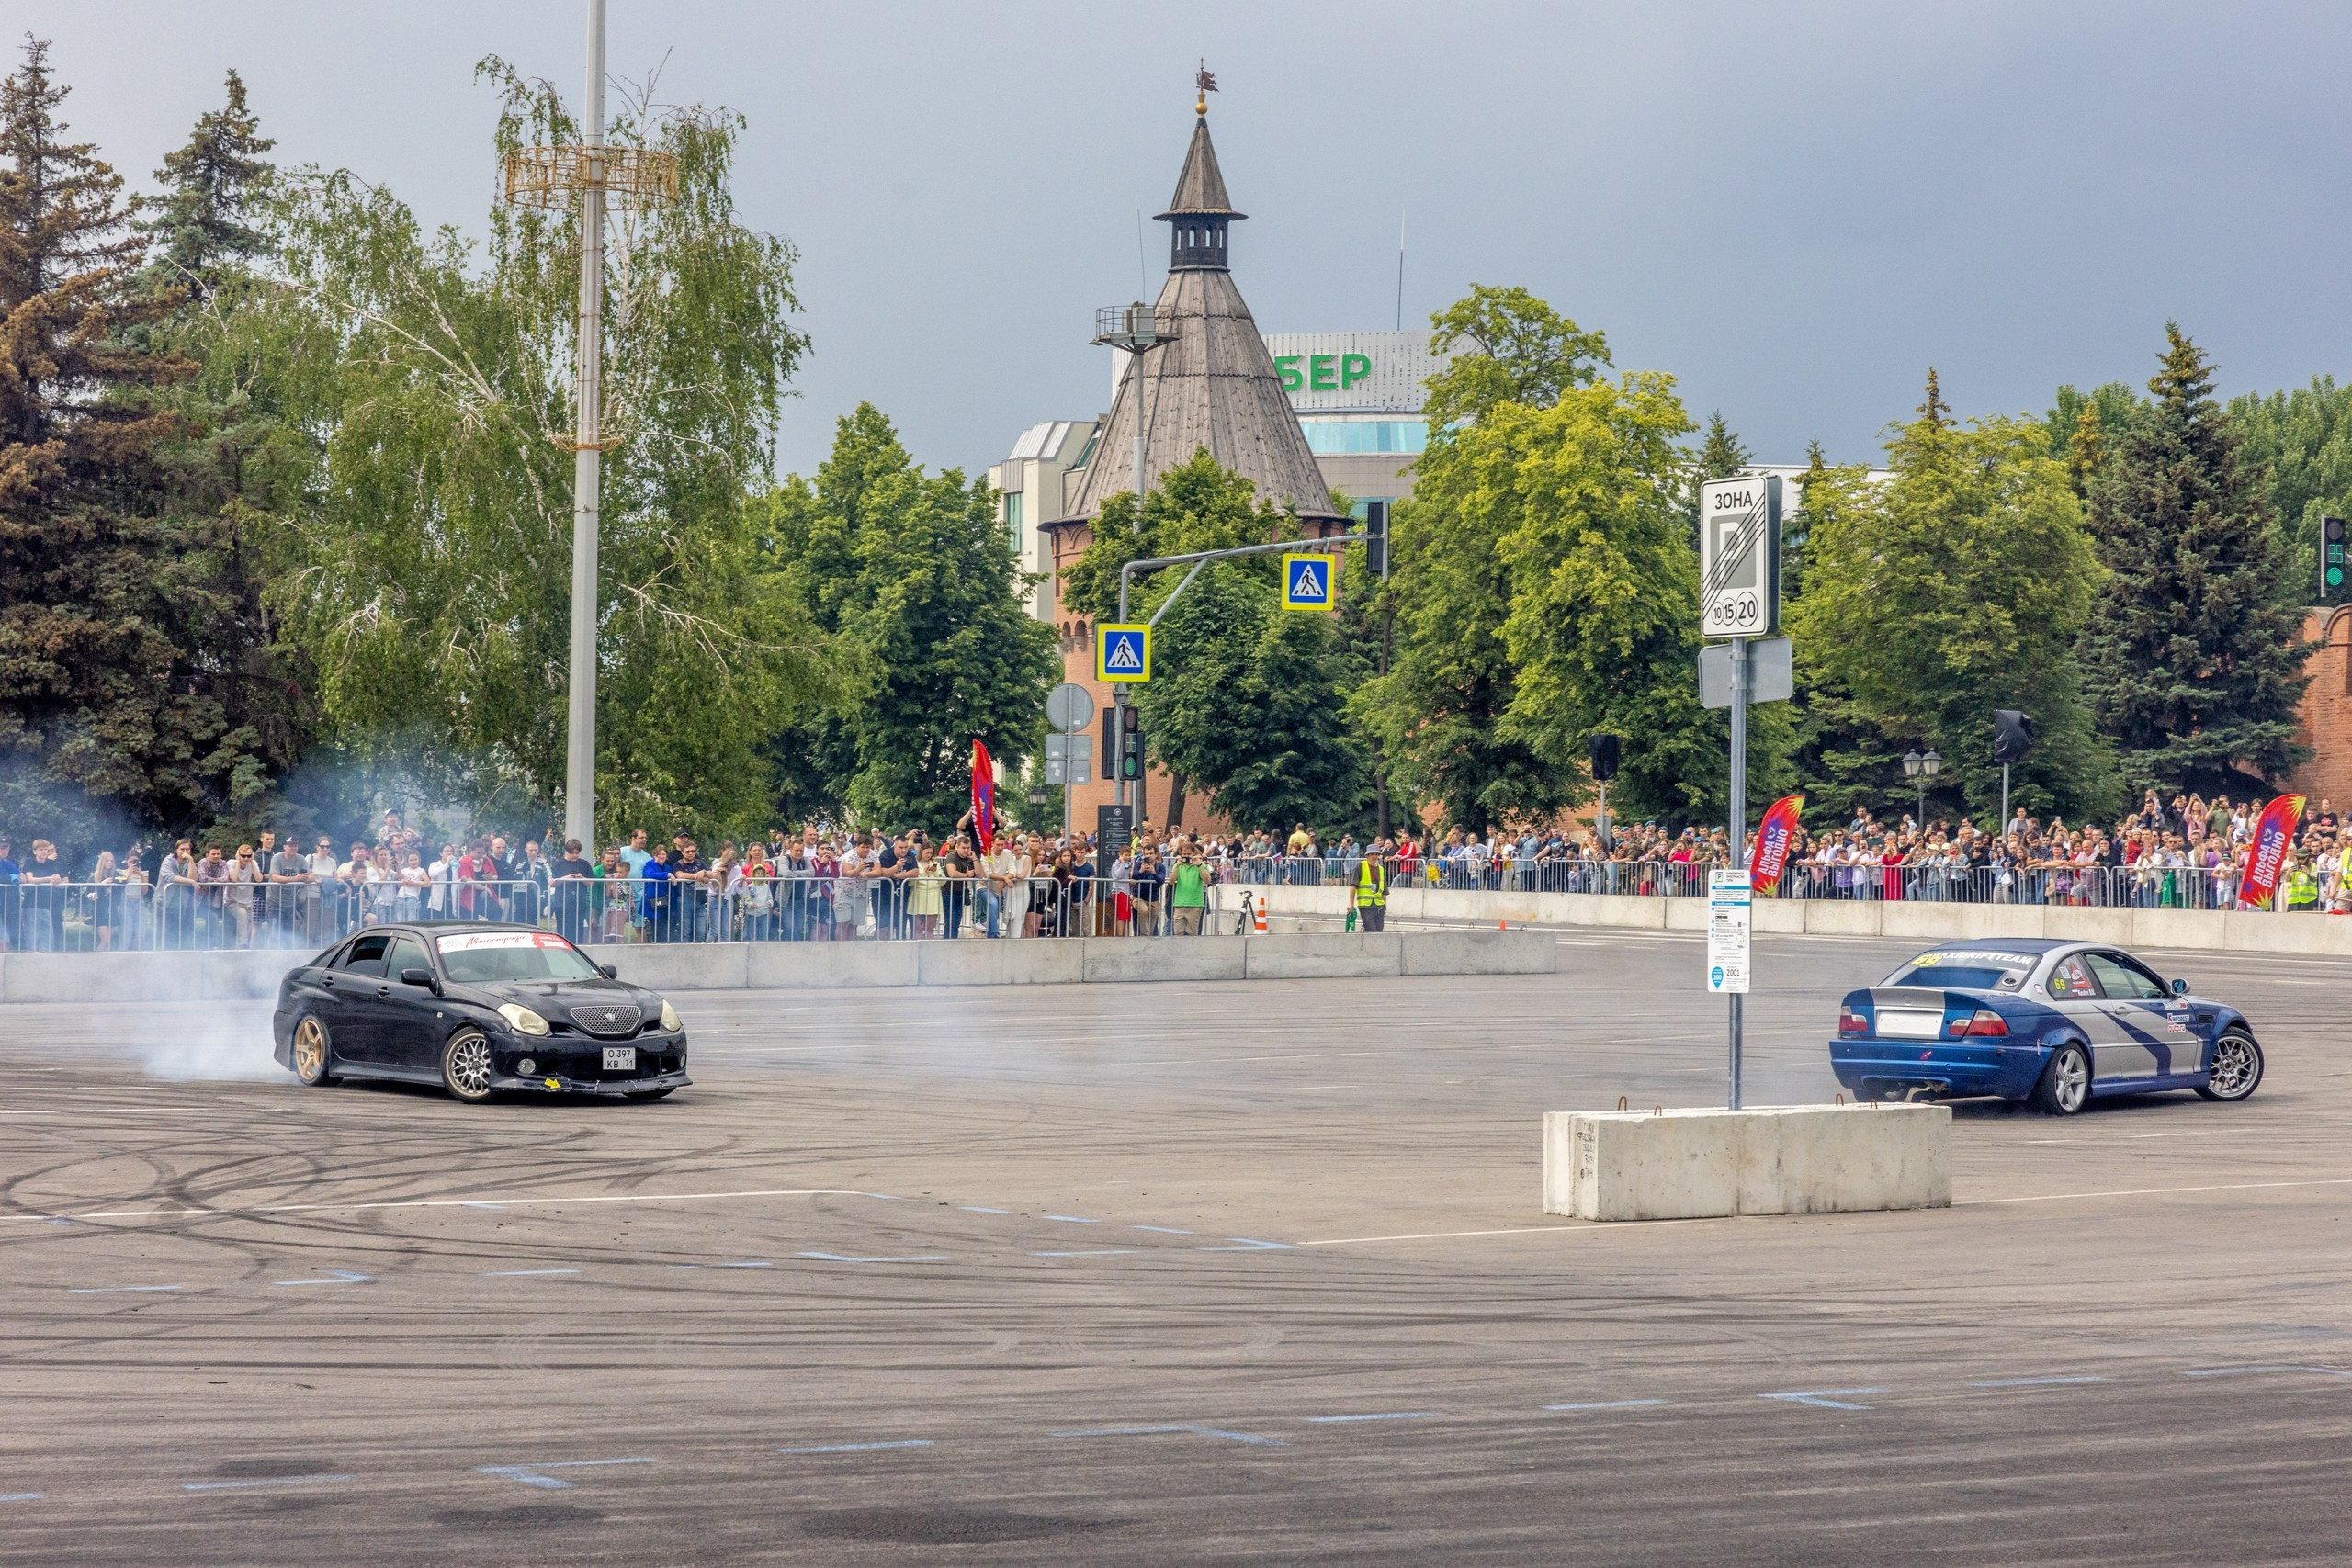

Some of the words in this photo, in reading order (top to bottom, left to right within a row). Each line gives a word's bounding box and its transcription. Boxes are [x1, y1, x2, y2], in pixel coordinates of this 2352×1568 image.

[1714, 491, 1753, 511] ЗОНА
[1719, 521, 1746, 583] P
[2328, 544, 2343, 563] 35
[1713, 607, 1722, 620] 10
[1724, 604, 1735, 620] 15
[1738, 600, 1757, 619] 20
[1758, 840, 1775, 874] АЛЬФА
[1768, 829, 1789, 877] ВЫГОДНО
[2261, 831, 2286, 889] ВЫГОДНО
[2252, 844, 2270, 885] АЛЬФА
[2053, 978, 2066, 990] 69
[616, 1049, 631, 1058] 397
[607, 1060, 619, 1068] КВ
